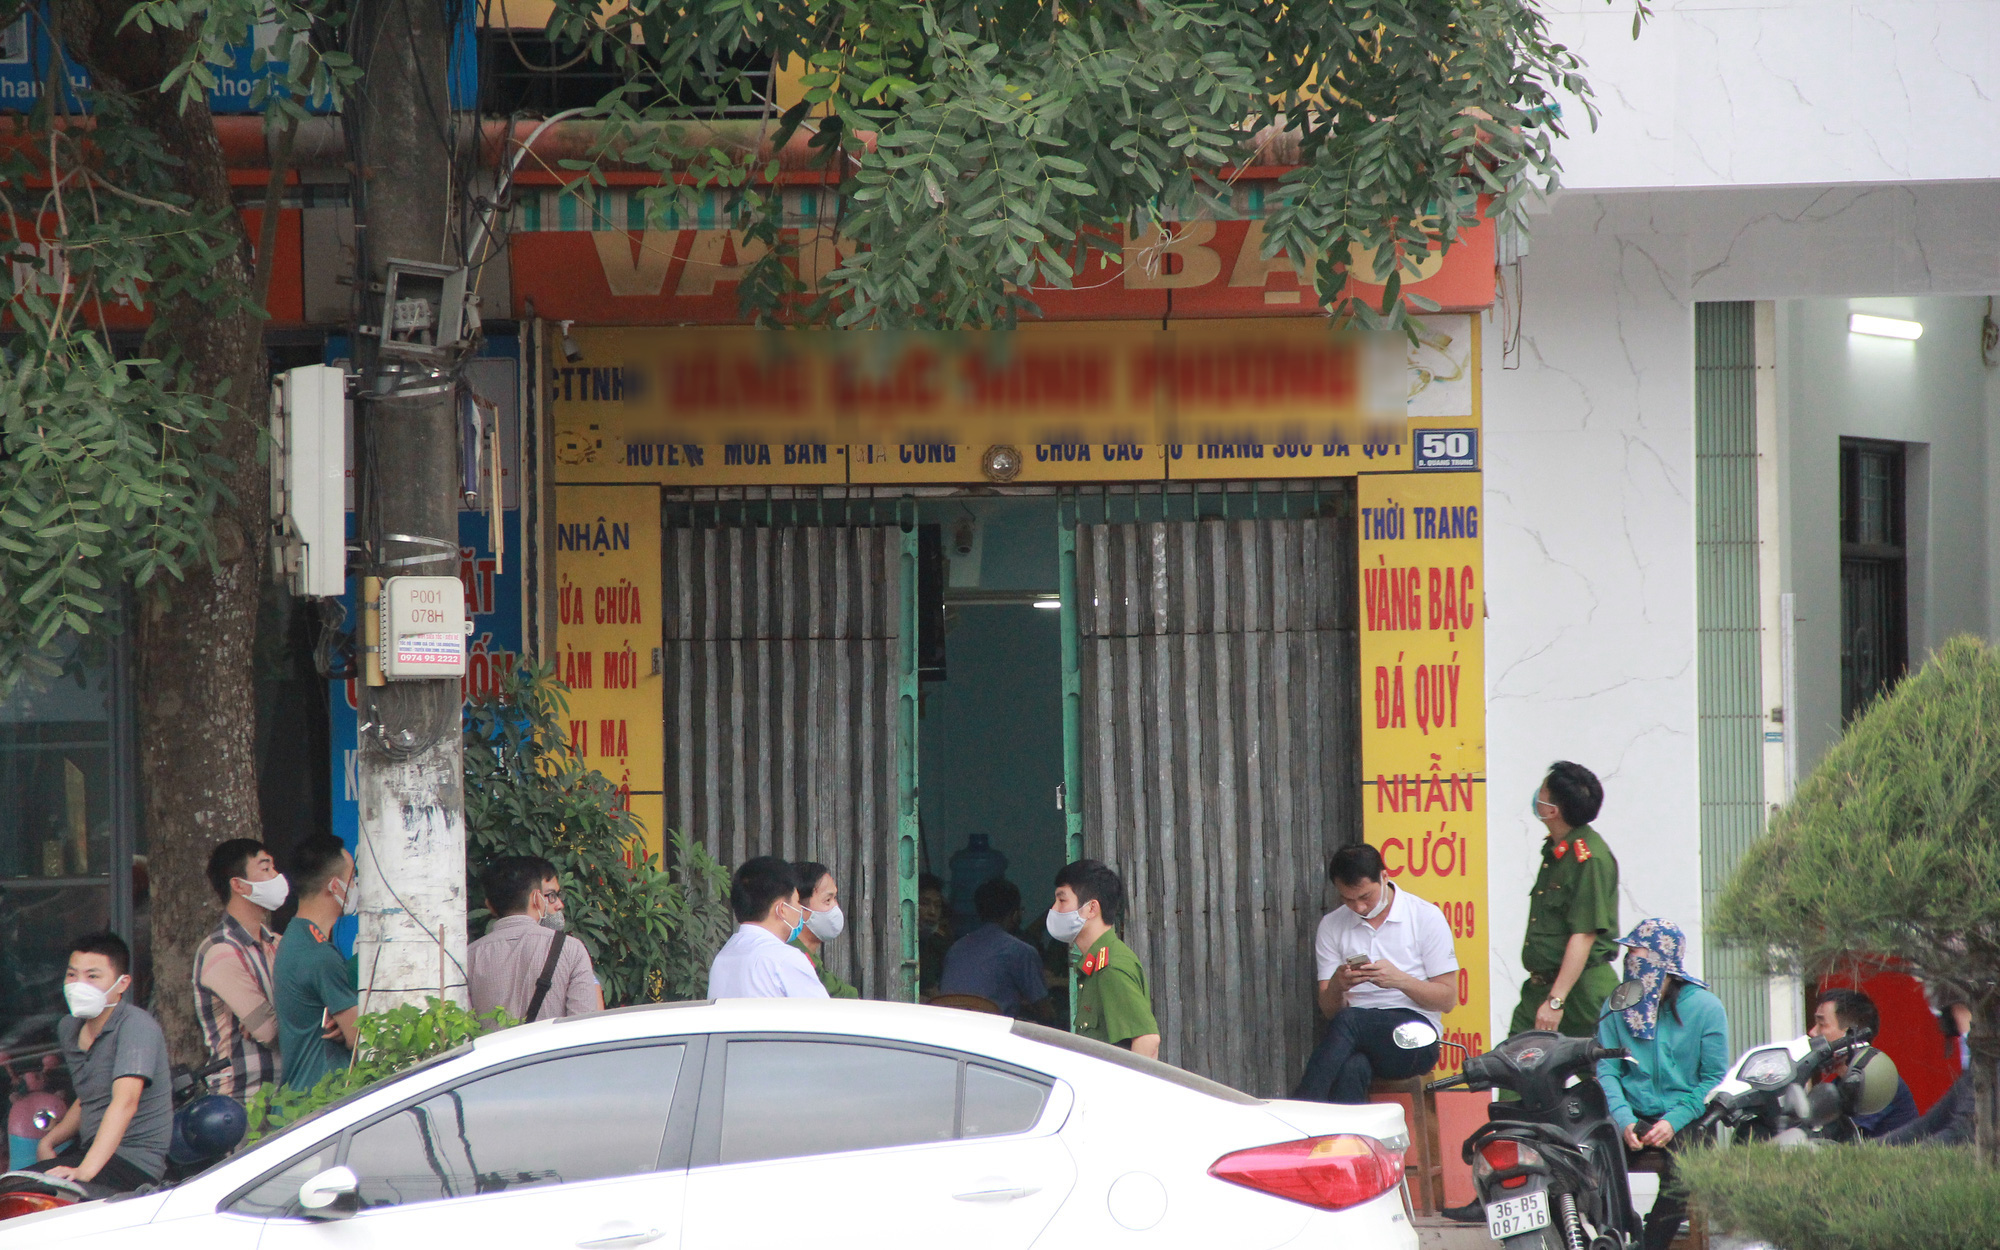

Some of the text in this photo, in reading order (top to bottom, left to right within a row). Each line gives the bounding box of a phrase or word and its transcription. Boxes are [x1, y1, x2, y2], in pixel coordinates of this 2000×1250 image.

[1422, 433, 1469, 458] 50
[557, 516, 630, 557] NHẬN
[1361, 497, 1478, 540] THỜI TRANG
[410, 590, 442, 604] P001
[411, 609, 444, 623] 078H
[557, 573, 642, 625] ỬA CHỮA
[1364, 554, 1474, 642] VÀNG BẠC
[400, 654, 459, 663] 0974 95 2222
[603, 639, 638, 689] MỚI
[1374, 651, 1461, 735] ĐÁ QUÝ
[600, 719, 629, 765] MẠ
[1380, 821, 1466, 877] CƯỚI
[1492, 1210, 1545, 1237] 087.16
[1495, 1194, 1538, 1219] 36-B5
